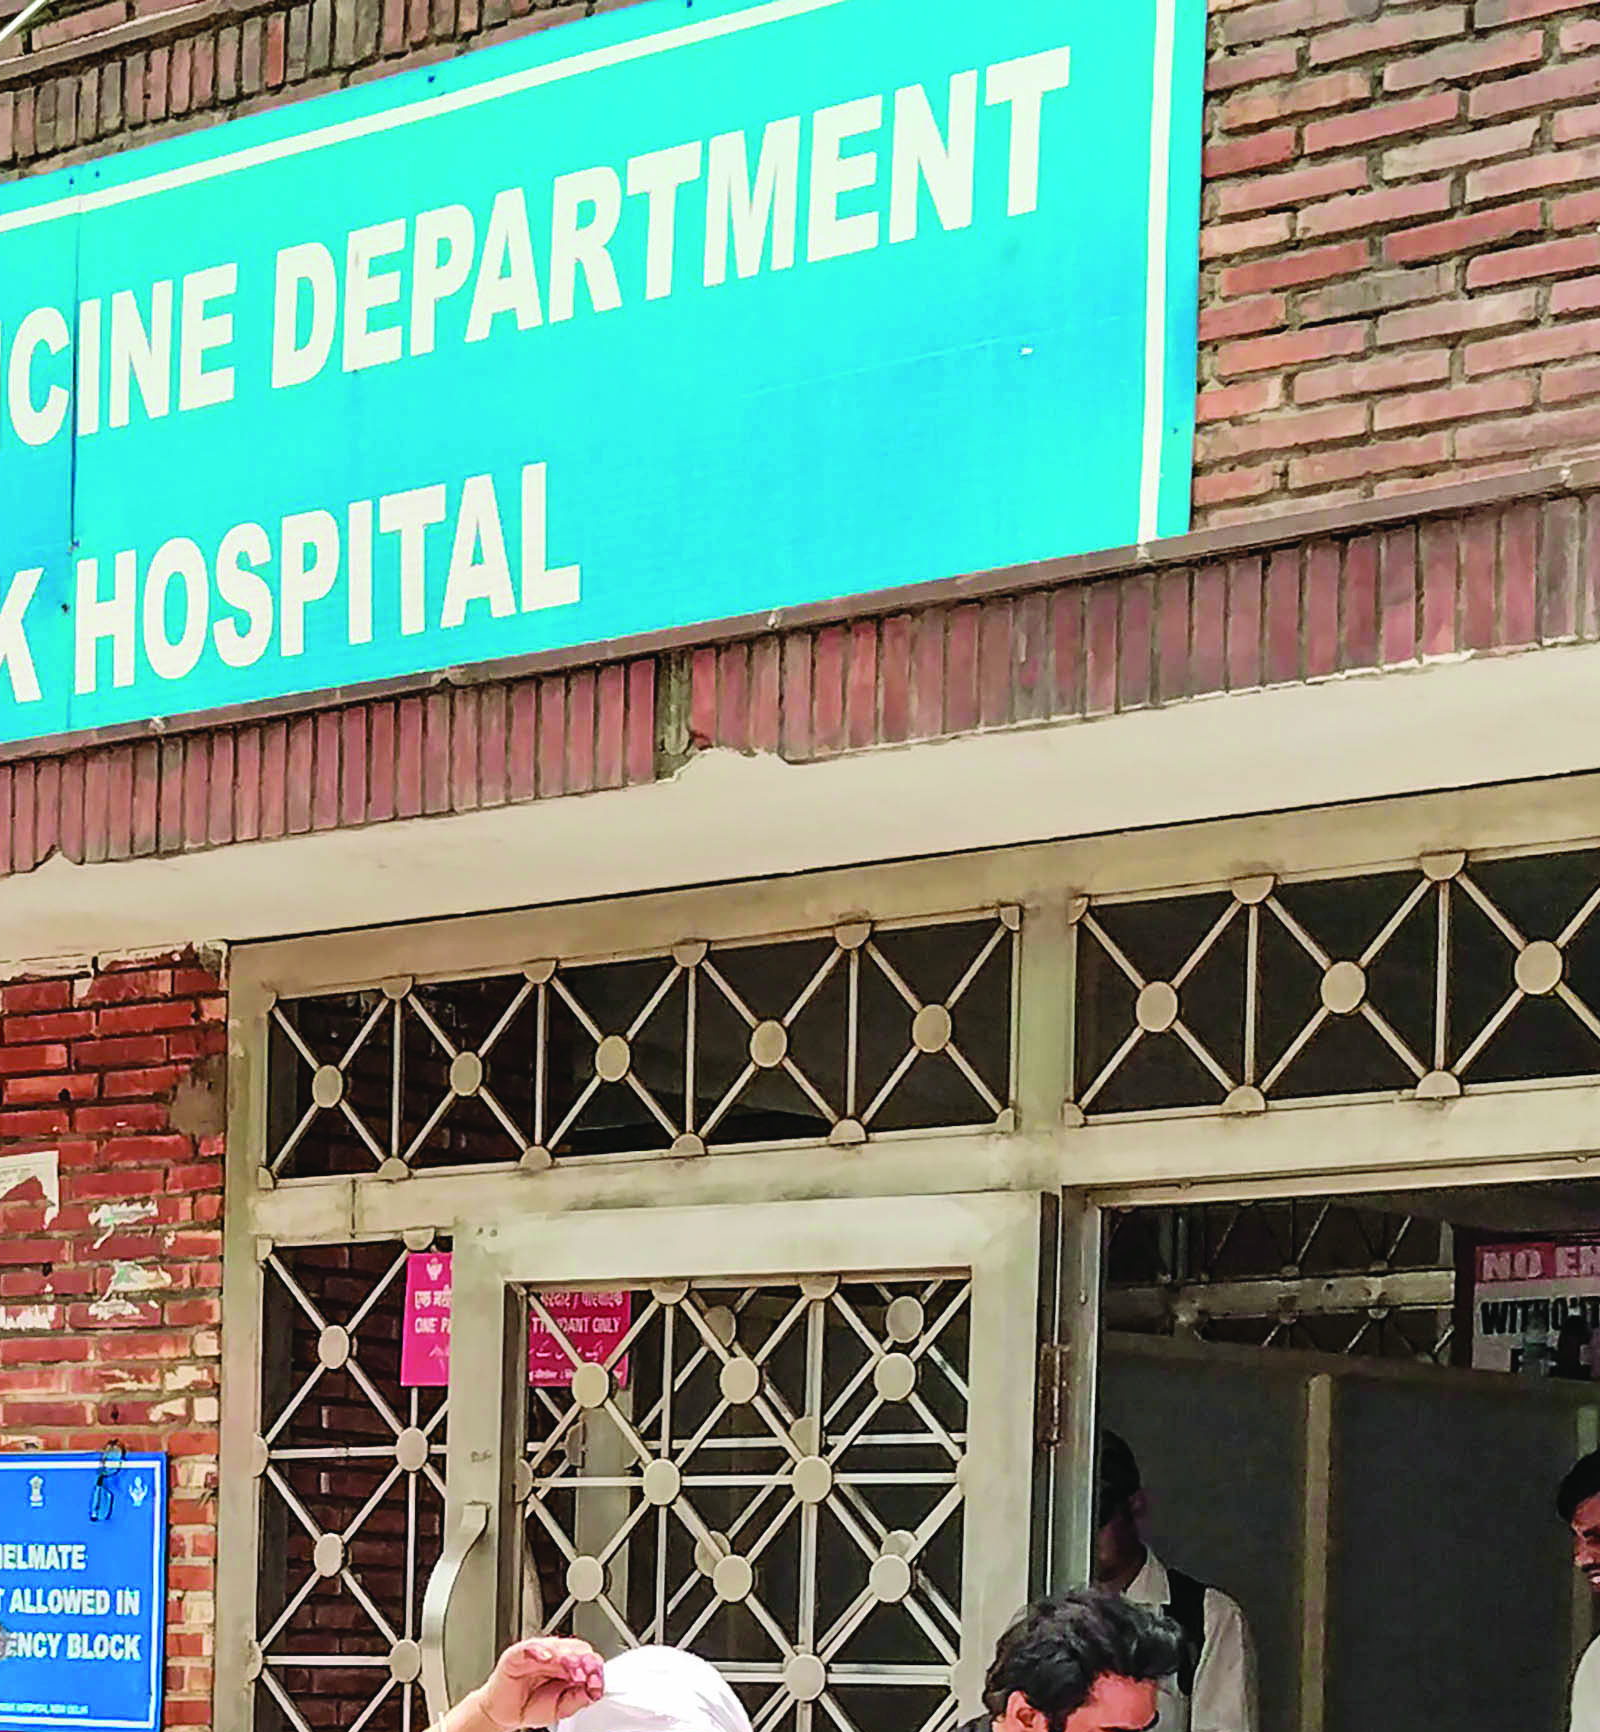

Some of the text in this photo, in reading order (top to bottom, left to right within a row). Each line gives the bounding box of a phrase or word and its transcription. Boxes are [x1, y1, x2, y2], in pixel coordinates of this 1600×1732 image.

[270, 47, 1071, 389] DEPARTMENT
[75, 461, 581, 696] HOSPITAL
[1482, 1250, 1543, 1281] NO
[8, 1588, 110, 1615] ALLOWED
[116, 1590, 140, 1616] IN
[67, 1634, 142, 1661] BLOCK
